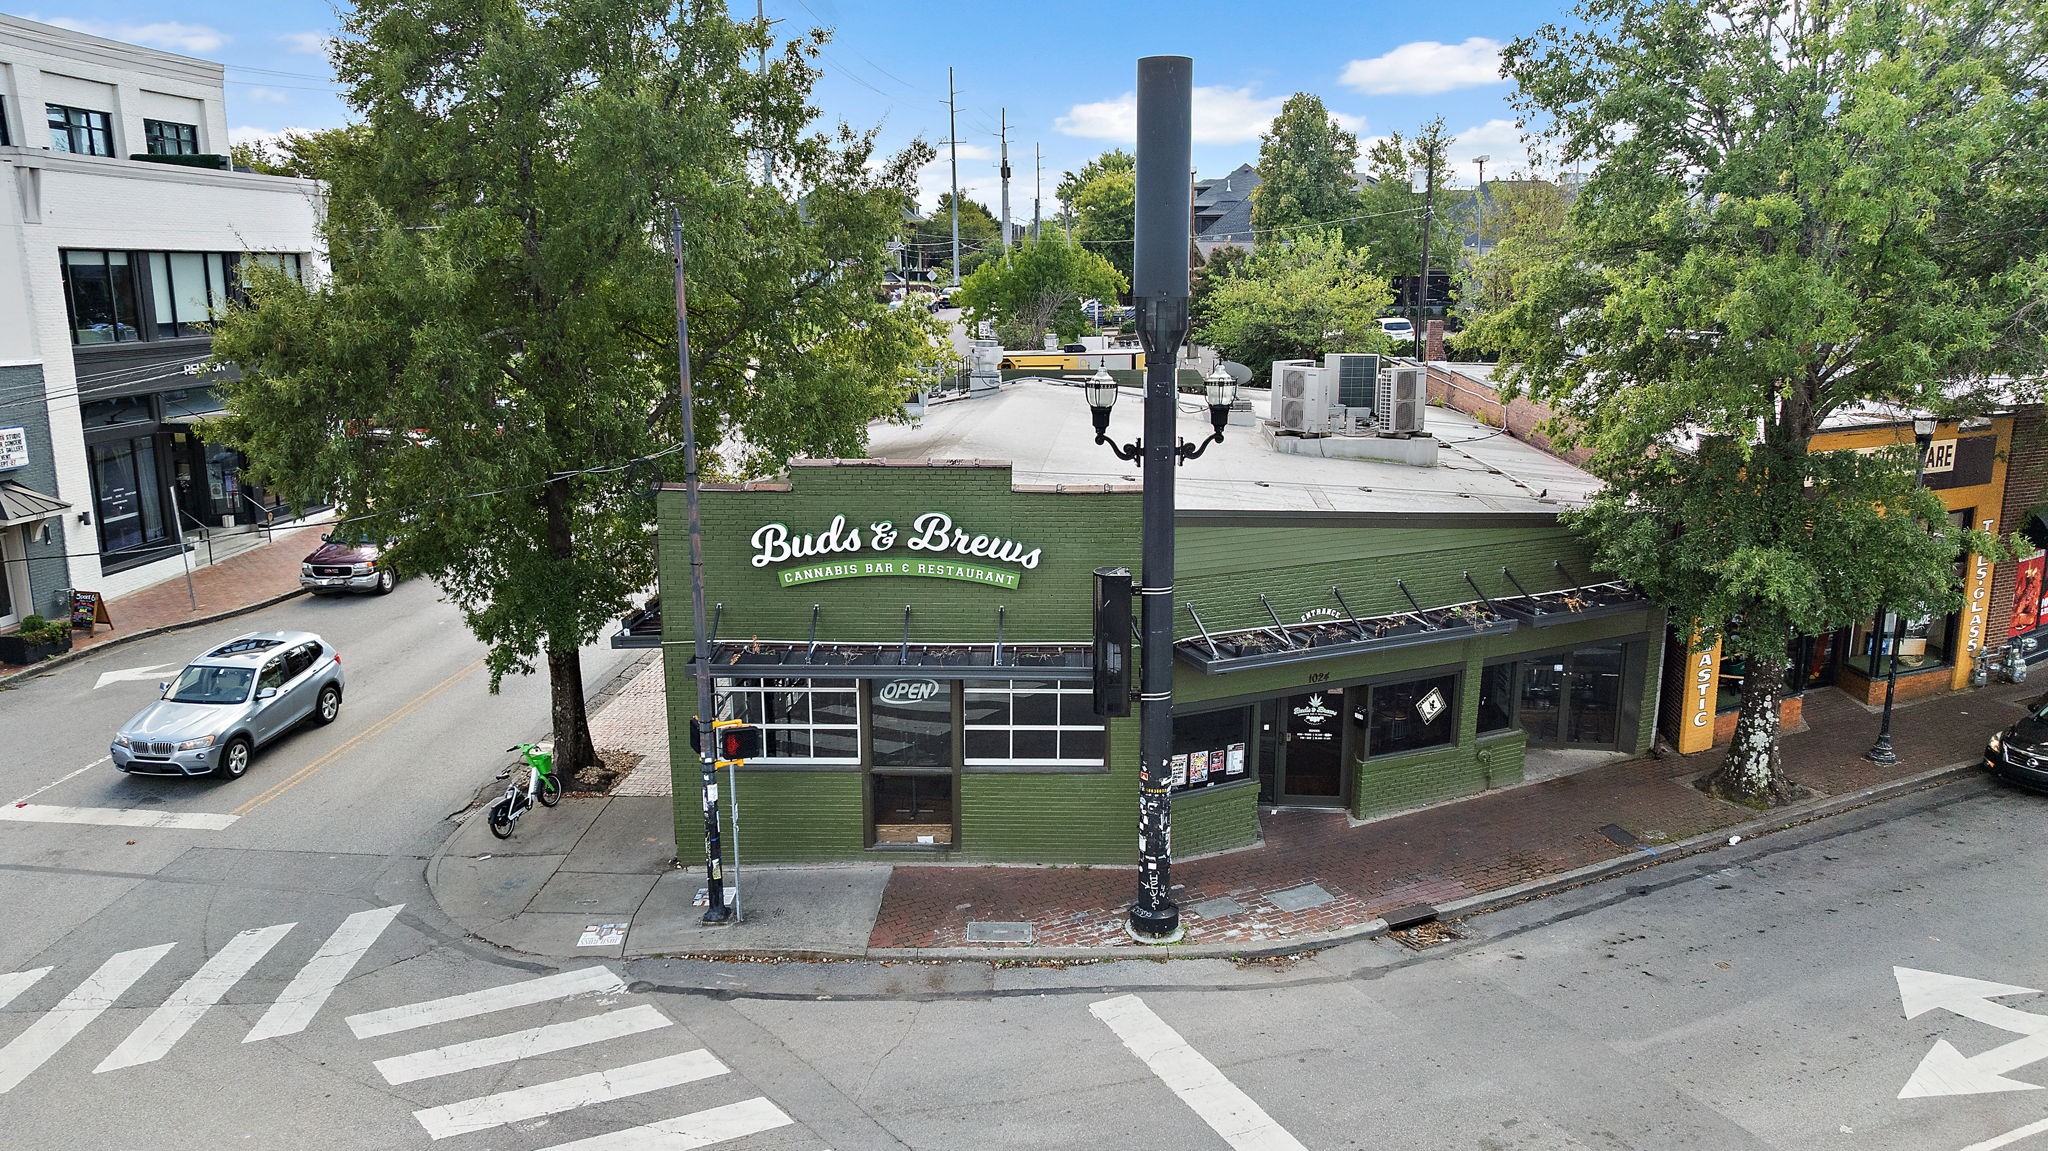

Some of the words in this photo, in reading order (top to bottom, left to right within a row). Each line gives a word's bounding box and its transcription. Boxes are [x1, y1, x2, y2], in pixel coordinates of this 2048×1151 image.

[750, 512, 861, 568] Buds
[870, 519, 898, 551] &
[906, 511, 1042, 569] Brews
[783, 562, 858, 584] CANNABIS
[864, 561, 894, 574] BAR
[917, 562, 1016, 586] RESTAURANT
[1300, 607, 1341, 622] ENTRANCE
[1308, 671, 1330, 683] 1024
[1693, 624, 1715, 728] ASTIC
[883, 682, 933, 699] OPEN
